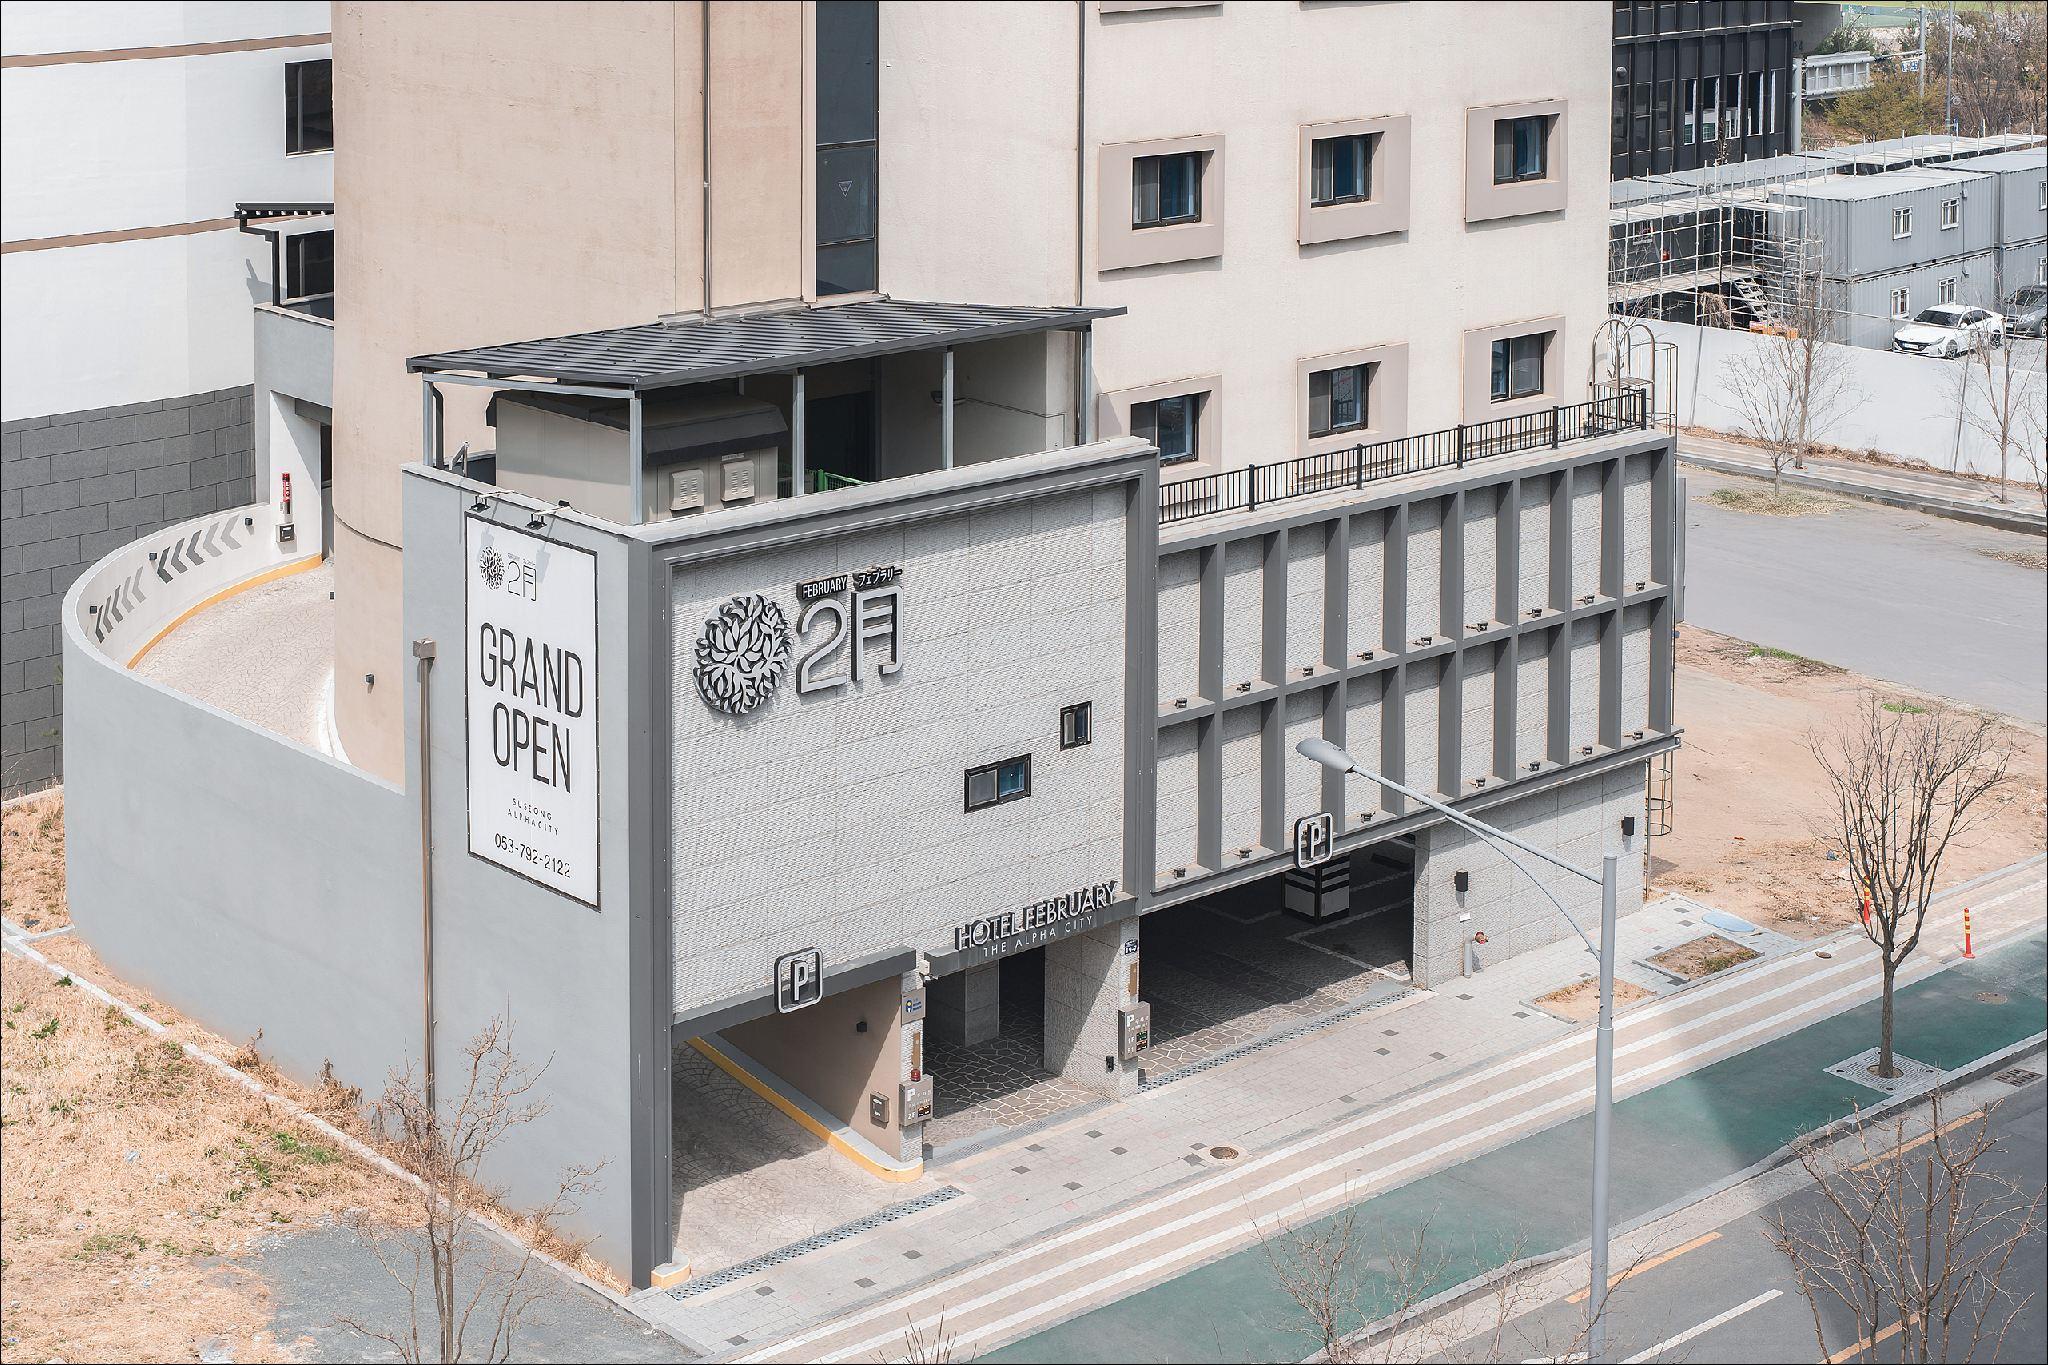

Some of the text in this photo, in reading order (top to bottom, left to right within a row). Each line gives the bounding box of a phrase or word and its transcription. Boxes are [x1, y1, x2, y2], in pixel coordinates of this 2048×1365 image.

[507, 560, 537, 602] 2月
[802, 576, 848, 599] FEBRUARY
[797, 585, 904, 695] 2月
[480, 622, 584, 718] GRAND
[492, 701, 573, 794] OPEN
[507, 808, 559, 836] ALPHACITY
[1308, 822, 1322, 859] P
[494, 832, 571, 879] 053-792-2122
[956, 881, 1118, 951] HOTEL FEBRUARY
[983, 915, 1093, 957] THE ALPHA CITY
[792, 960, 809, 1001] P
[1126, 1014, 1135, 1027] P
[906, 1088, 916, 1102] P
